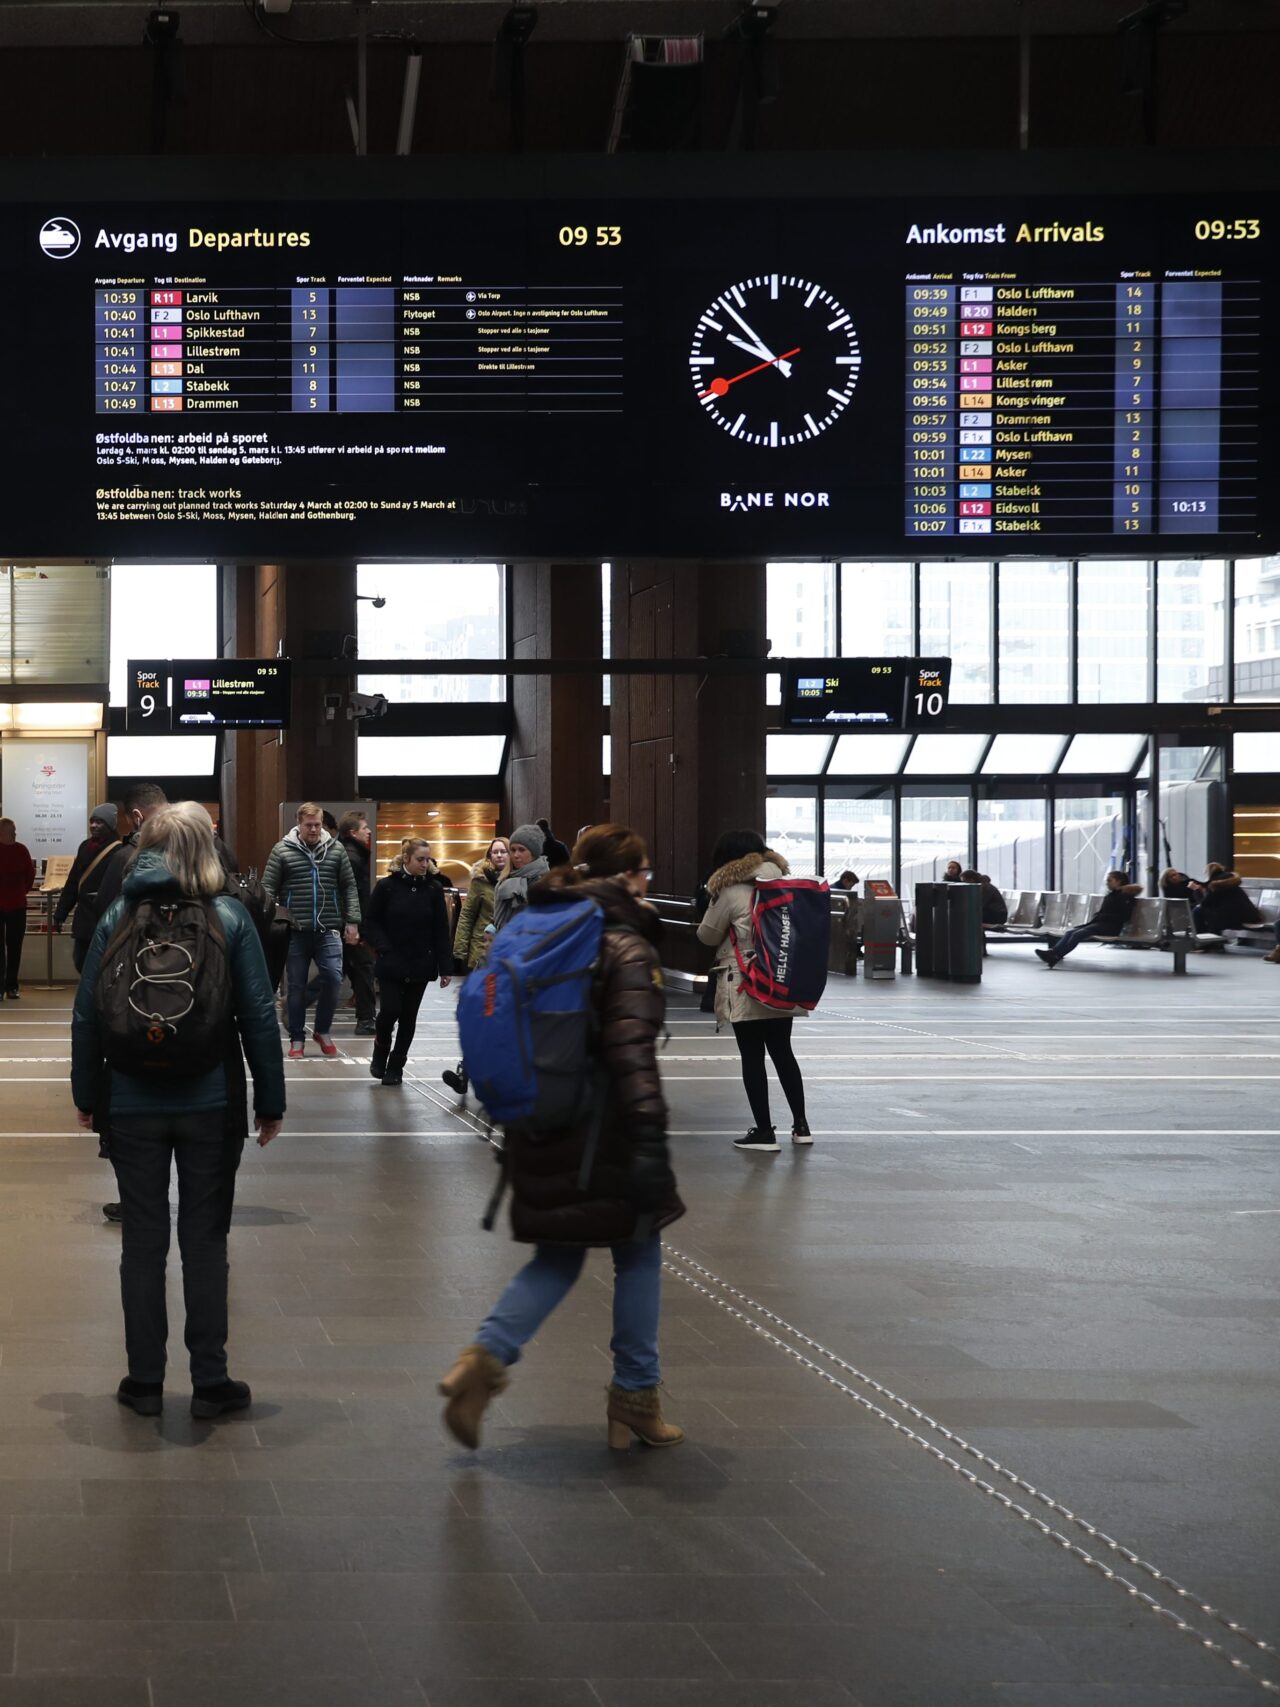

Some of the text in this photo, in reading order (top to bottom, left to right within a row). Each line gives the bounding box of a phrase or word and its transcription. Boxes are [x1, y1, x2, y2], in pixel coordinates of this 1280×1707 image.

[906, 222, 1104, 243] Ankomst Arrivals
[1195, 220, 1260, 239] 09:53
[95, 228, 310, 252] Avgang Departures
[104, 293, 218, 303] 10:39 Larvik
[997, 288, 1074, 299] Oslo Lufthavn
[104, 310, 259, 320] 10:40 Oslo Lufthavn
[104, 327, 244, 339] 10:41 Spikkestad
[997, 324, 1056, 336] Kongsberg
[104, 346, 240, 356] 10:41 Lillestrøm
[997, 342, 1073, 353] Oslo Lufthavn
[105, 363, 204, 374] 10:44 Dal
[996, 360, 1028, 370] Asker
[105, 381, 229, 391] 10:47 Stabekk
[997, 378, 1052, 388] Lillestrøm
[105, 399, 238, 408] 10:49 Drammen
[997, 396, 1065, 407] Kongsvinger
[178, 433, 212, 443] arbeid
[216, 432, 229, 444] på
[232, 433, 268, 444] sporet
[996, 431, 1072, 442] Oslo Lufthavn
[995, 467, 1026, 477] Asker
[178, 488, 205, 498] track
[209, 488, 241, 498] works
[785, 493, 829, 506] NOR
[97, 502, 107, 510] We
[126, 502, 160, 512] carrying
[163, 502, 176, 510] out
[178, 502, 210, 512] planned
[213, 502, 232, 510] track
[235, 502, 258, 510] works
[260, 502, 296, 512] Saturday
[299, 502, 304, 510] 4
[307, 502, 332, 510] March
[334, 502, 342, 510] at
[345, 501, 368, 509] 02:00
[380, 501, 411, 511] Sunday
[414, 501, 418, 509] 5
[420, 501, 445, 509] March
[996, 501, 1206, 513] Eidsvoll 10:13
[97, 512, 356, 522] 13:45 between Oslo S-Ski, Moss, Mysen, Halden and Gothenburg.
[137, 671, 156, 680] Spor
[920, 670, 939, 678] Spor
[137, 680, 159, 688] Track
[213, 680, 254, 688] Lillestrøm
[919, 678, 942, 686] Track
[141, 695, 154, 717] 9
[915, 693, 943, 715] 10
[776, 907, 790, 982] HELLY HANSEN
